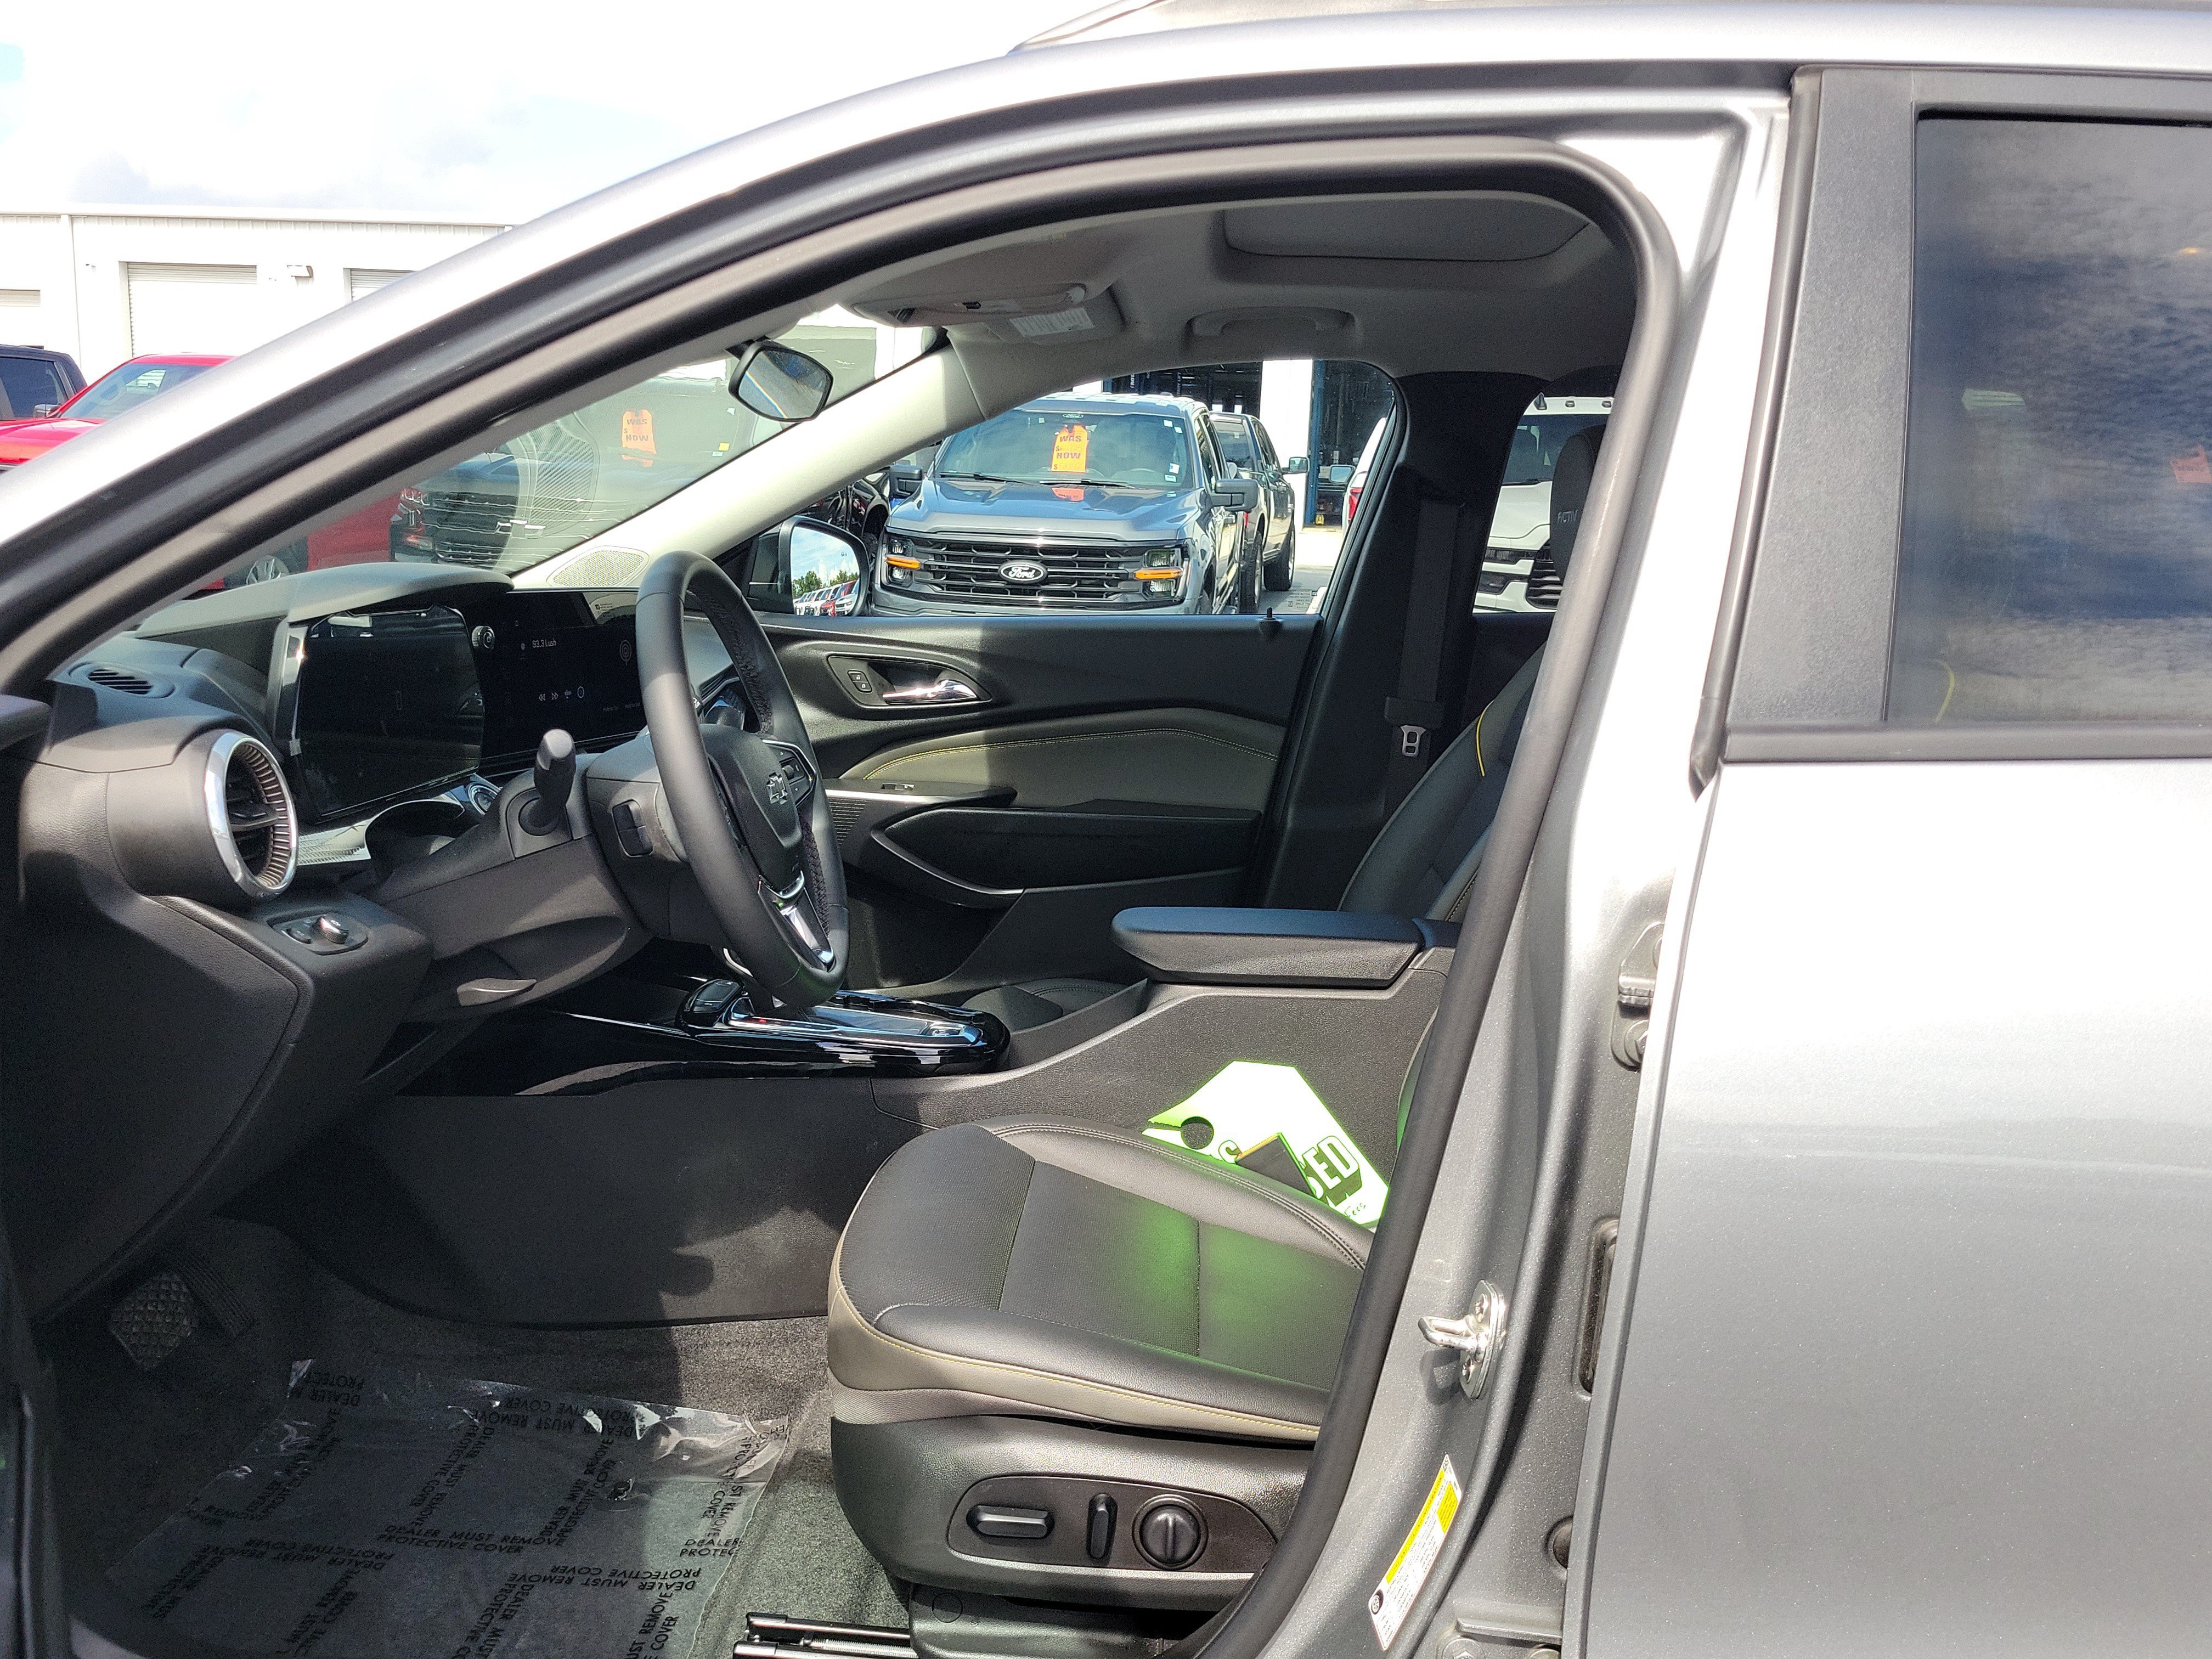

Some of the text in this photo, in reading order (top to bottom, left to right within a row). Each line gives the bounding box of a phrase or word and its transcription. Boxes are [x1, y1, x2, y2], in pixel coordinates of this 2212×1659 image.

[505, 1396, 551, 1412] COVER
[535, 1416, 575, 1431] MUST
[701, 1489, 725, 1519] COVER
[707, 1502, 736, 1538] REMOVE
[377, 1534, 524, 1554] PROTECTIVE COVER
[385, 1525, 566, 1547] DEALER MUST REMOVE
[684, 1538, 741, 1547] DEALER
[507, 1573, 696, 1590] DEALER MUST REMOVE
[551, 1565, 702, 1579] PROTECTIVE COVER
[499, 1583, 535, 1620] DEALER
[464, 1583, 516, 1643] PROTECTIVE
[624, 1641, 646, 1659] UST
[638, 1592, 673, 1634] REMOVE
[650, 1616, 680, 1651] COVER
